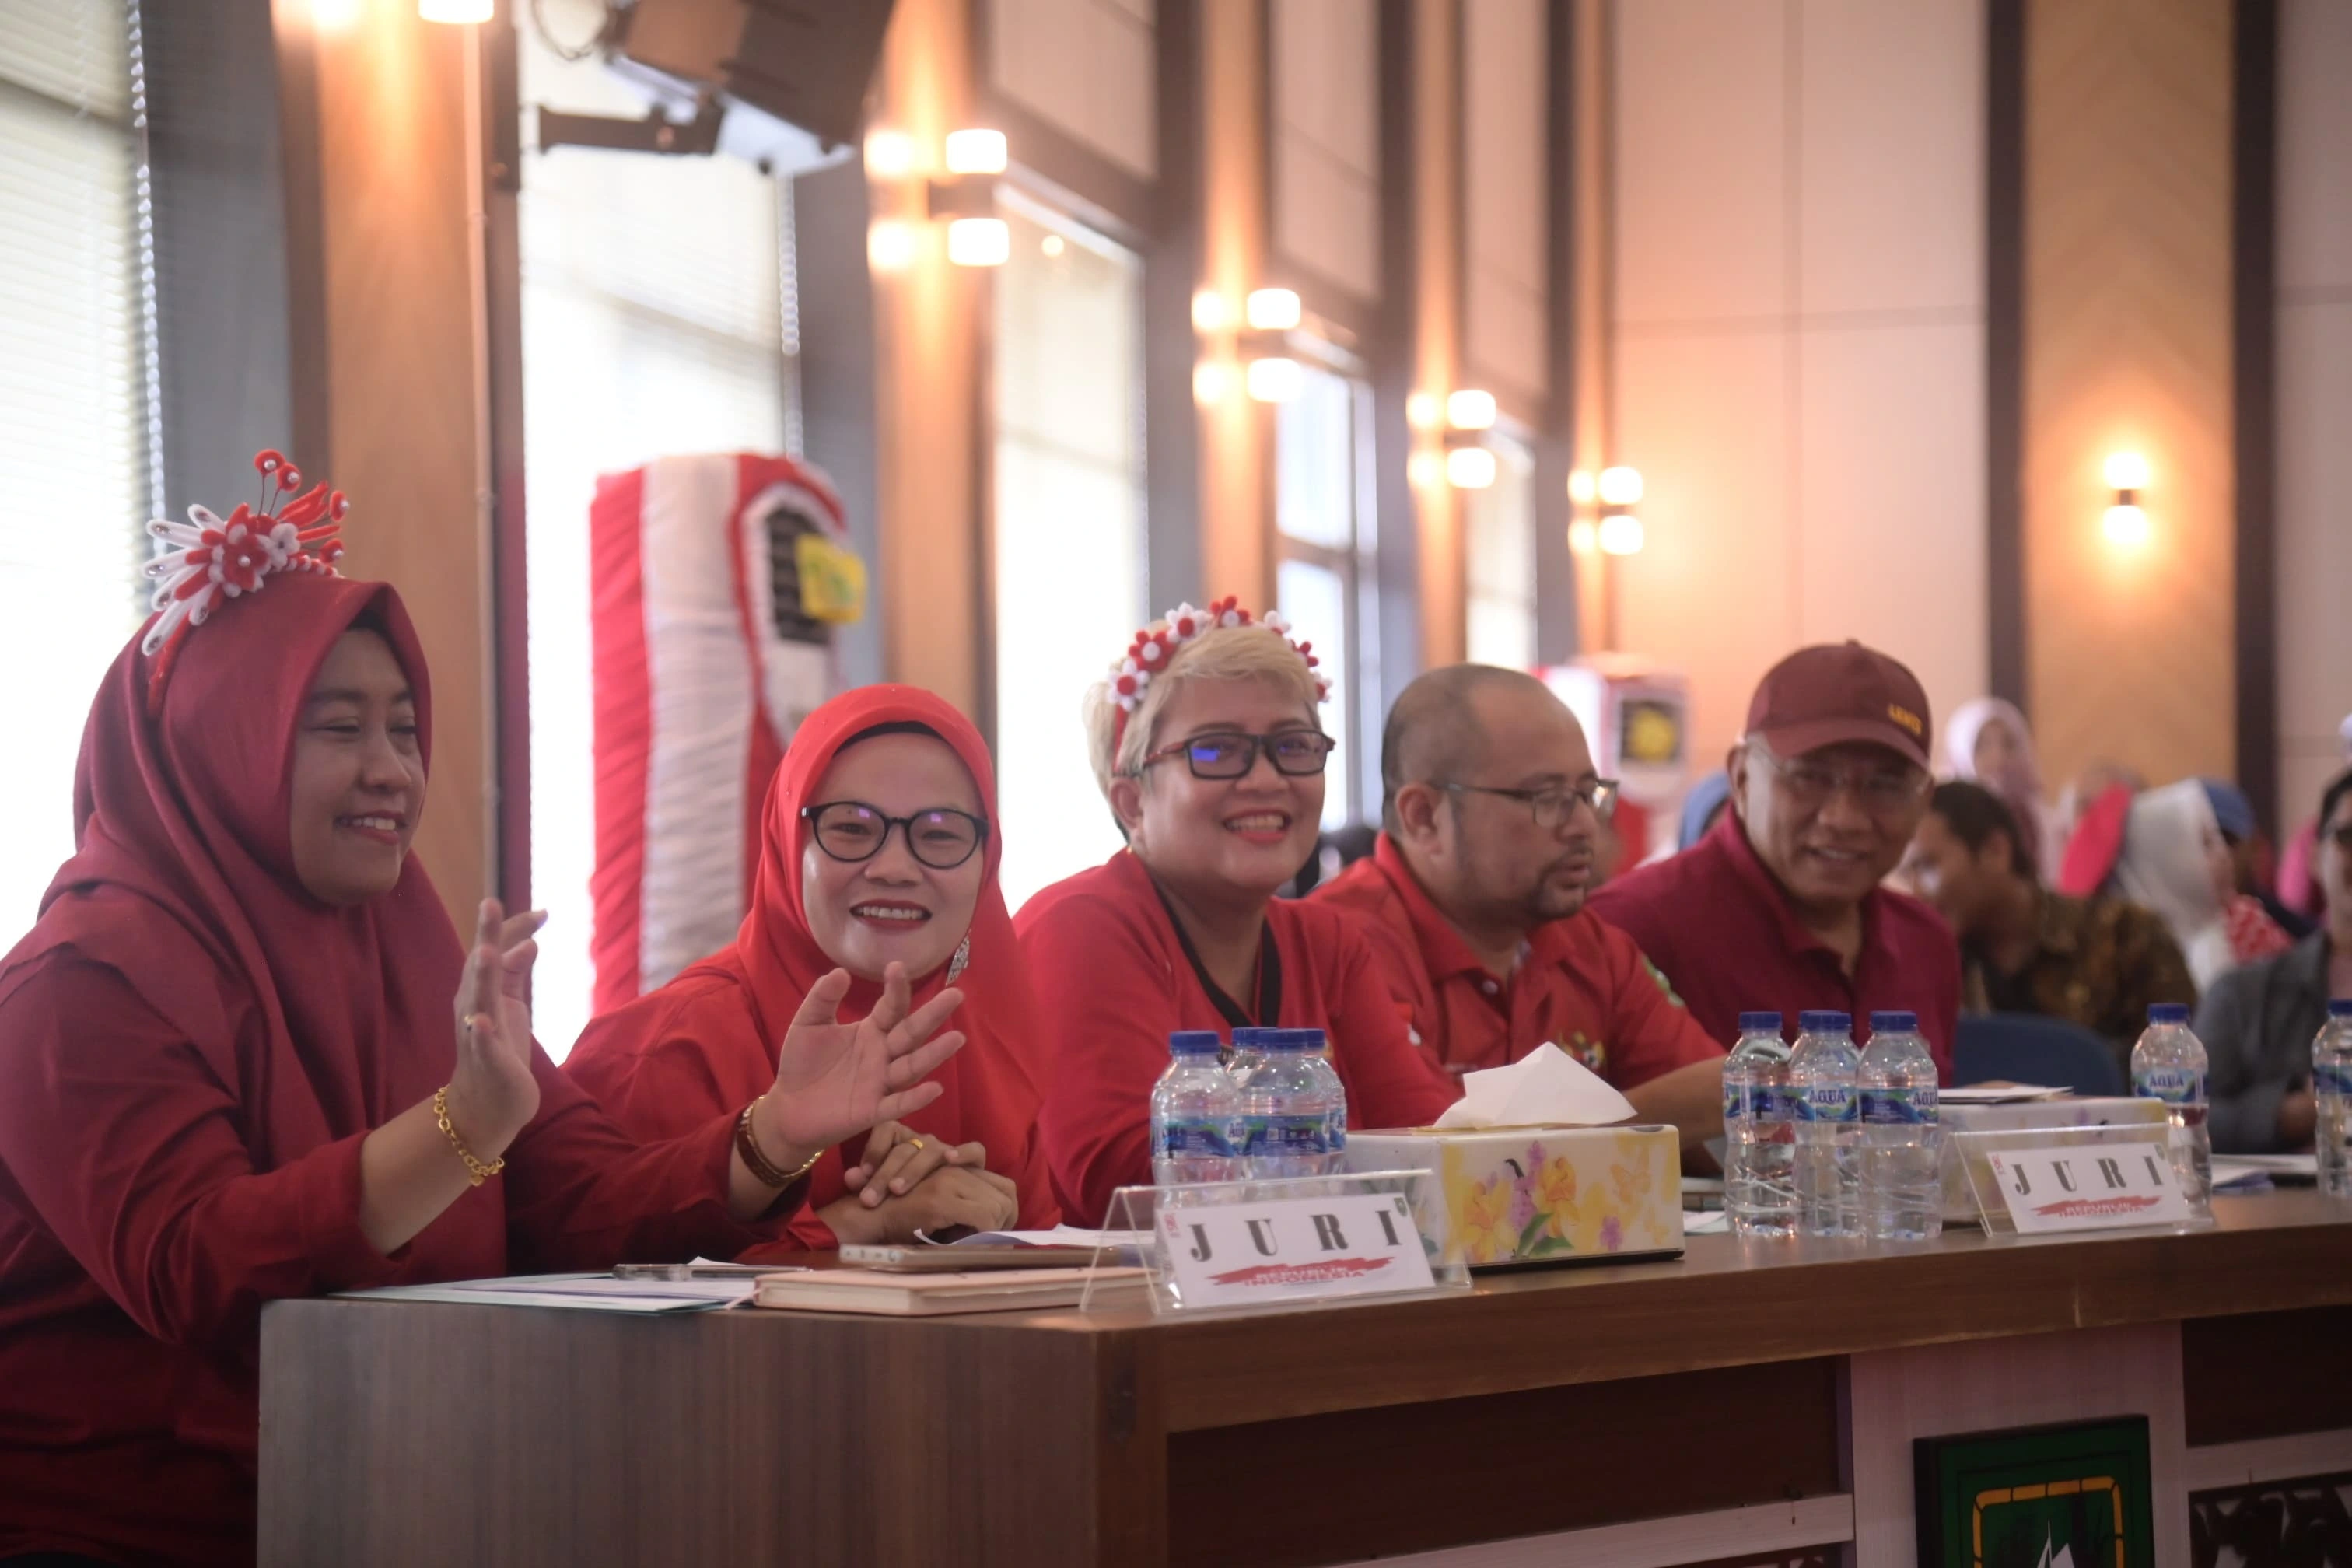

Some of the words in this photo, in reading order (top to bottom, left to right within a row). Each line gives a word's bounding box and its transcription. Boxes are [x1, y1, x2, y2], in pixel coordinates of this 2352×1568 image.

[1809, 1090, 1846, 1103] AQUA
[1913, 1091, 1937, 1107] AQU
[2011, 1155, 2164, 1195] JURI
[1188, 1209, 1403, 1262] JURI
